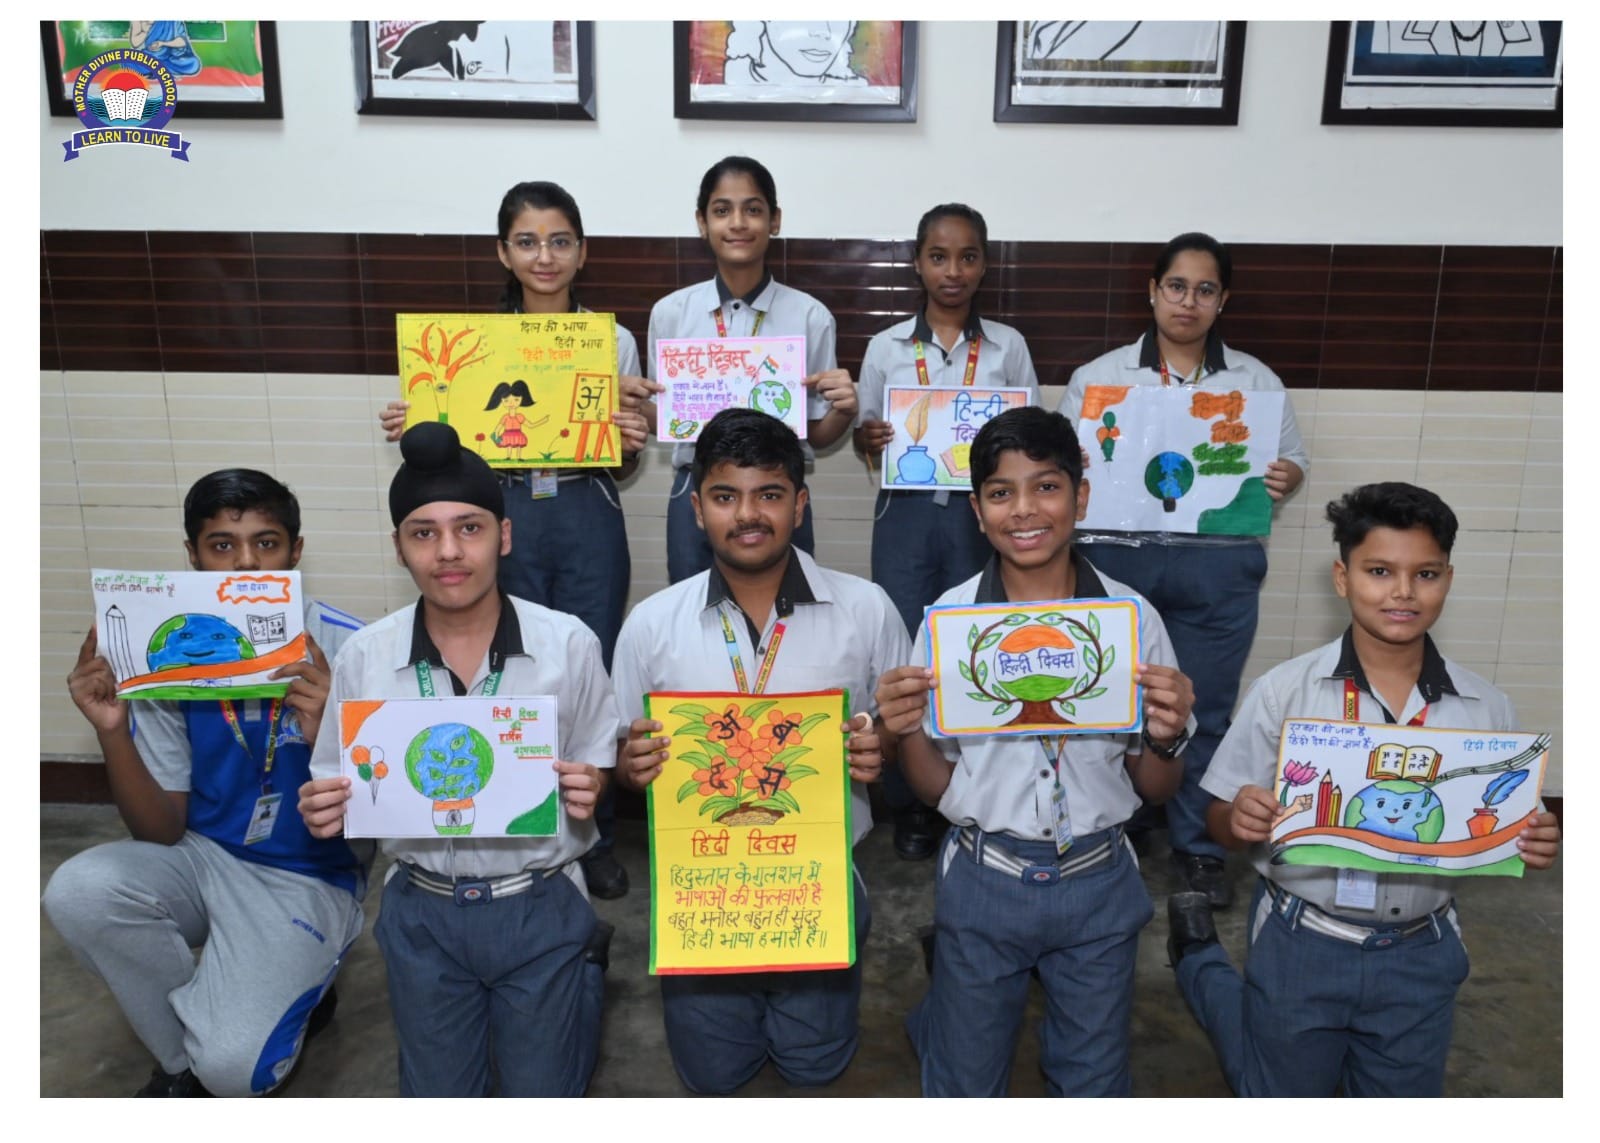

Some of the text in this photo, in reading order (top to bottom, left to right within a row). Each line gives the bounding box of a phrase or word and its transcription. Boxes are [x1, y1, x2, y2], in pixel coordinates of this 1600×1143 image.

[544, 319, 558, 332] की
[562, 321, 589, 332] भाषा
[580, 338, 605, 349] भाषा
[576, 386, 605, 410] अ
[952, 391, 1009, 422] हिन्दी
[999, 648, 1074, 675] हिन्दी दिवस
[712, 710, 741, 739] अ
[758, 766, 786, 796] स
[691, 828, 797, 857] हिंदी दिवस
[670, 860, 822, 889] हिंदुस्तान के गुलशन में
[729, 884, 752, 906] की
[668, 906, 822, 931] बहुत मनोहर बहुत ही सुंदर
[682, 928, 714, 950] हिंदी
[719, 932, 754, 949] भाषा
[758, 928, 801, 949] हमारी
